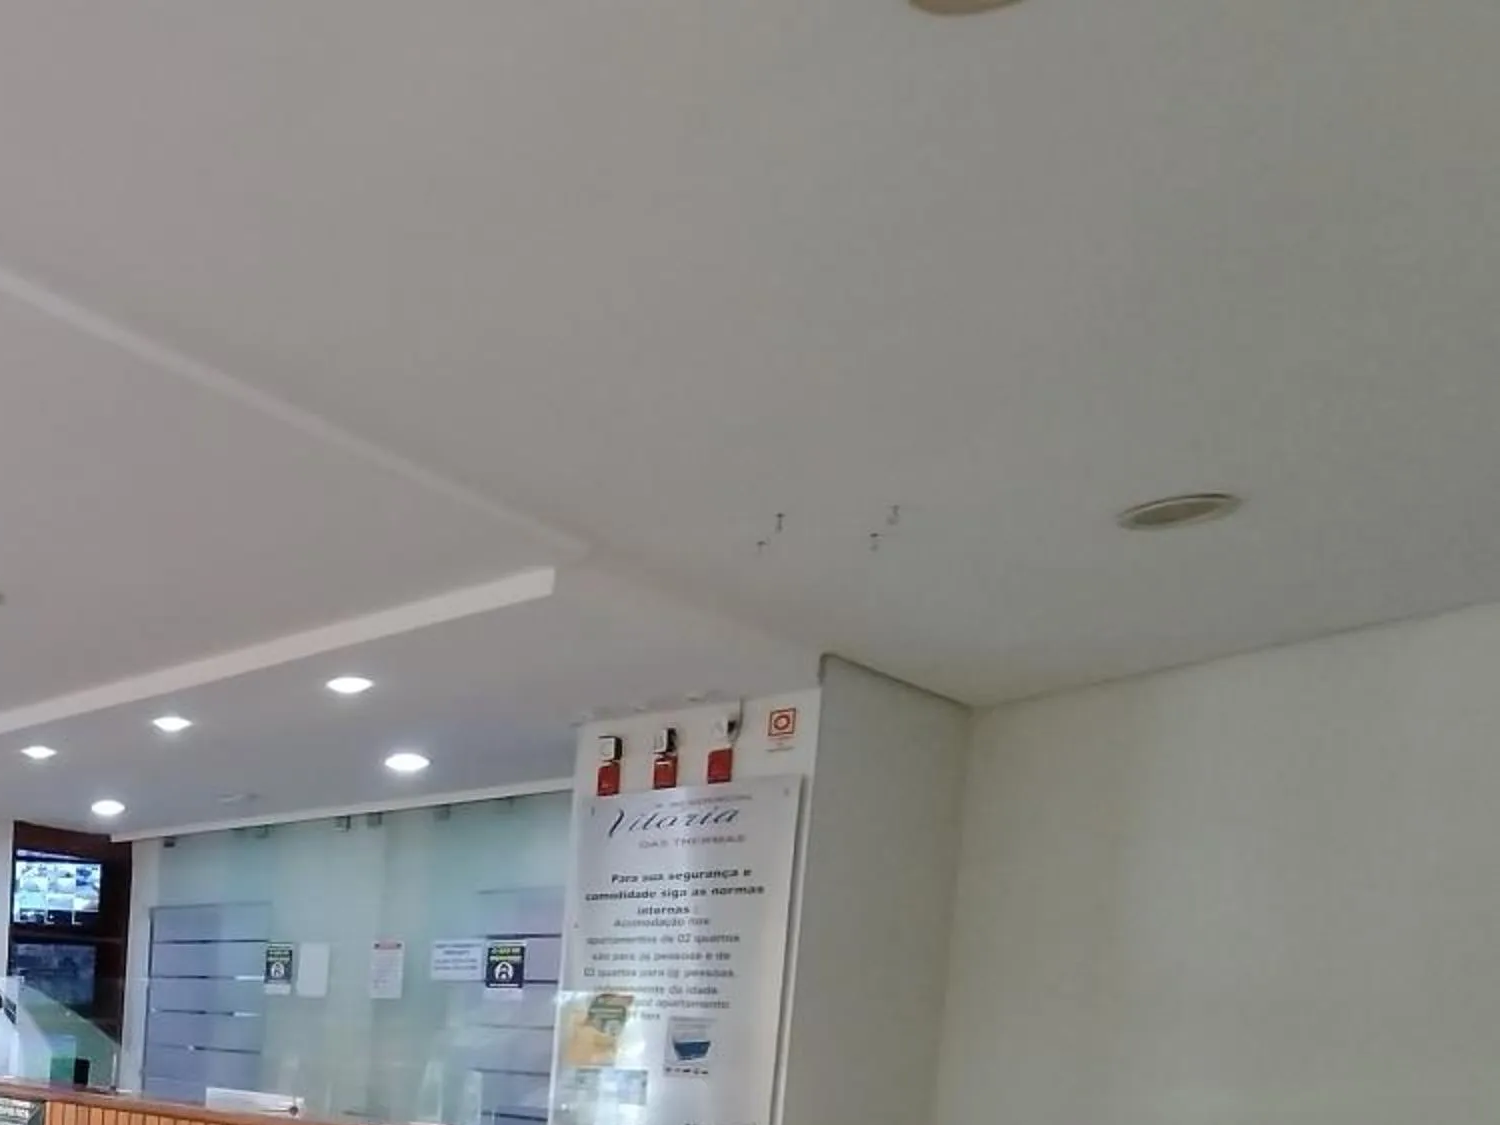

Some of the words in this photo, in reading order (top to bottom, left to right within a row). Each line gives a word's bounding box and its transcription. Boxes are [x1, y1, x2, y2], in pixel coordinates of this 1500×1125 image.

[611, 873, 640, 884] Para
[642, 872, 664, 882] sua
[668, 868, 739, 884] segurança
[743, 868, 753, 877] e
[585, 886, 657, 901] comodidade
[660, 887, 688, 900] siga
[691, 887, 707, 897] as
[711, 884, 765, 896] normas
[637, 904, 691, 916] internas
[677, 933, 691, 944] 02
